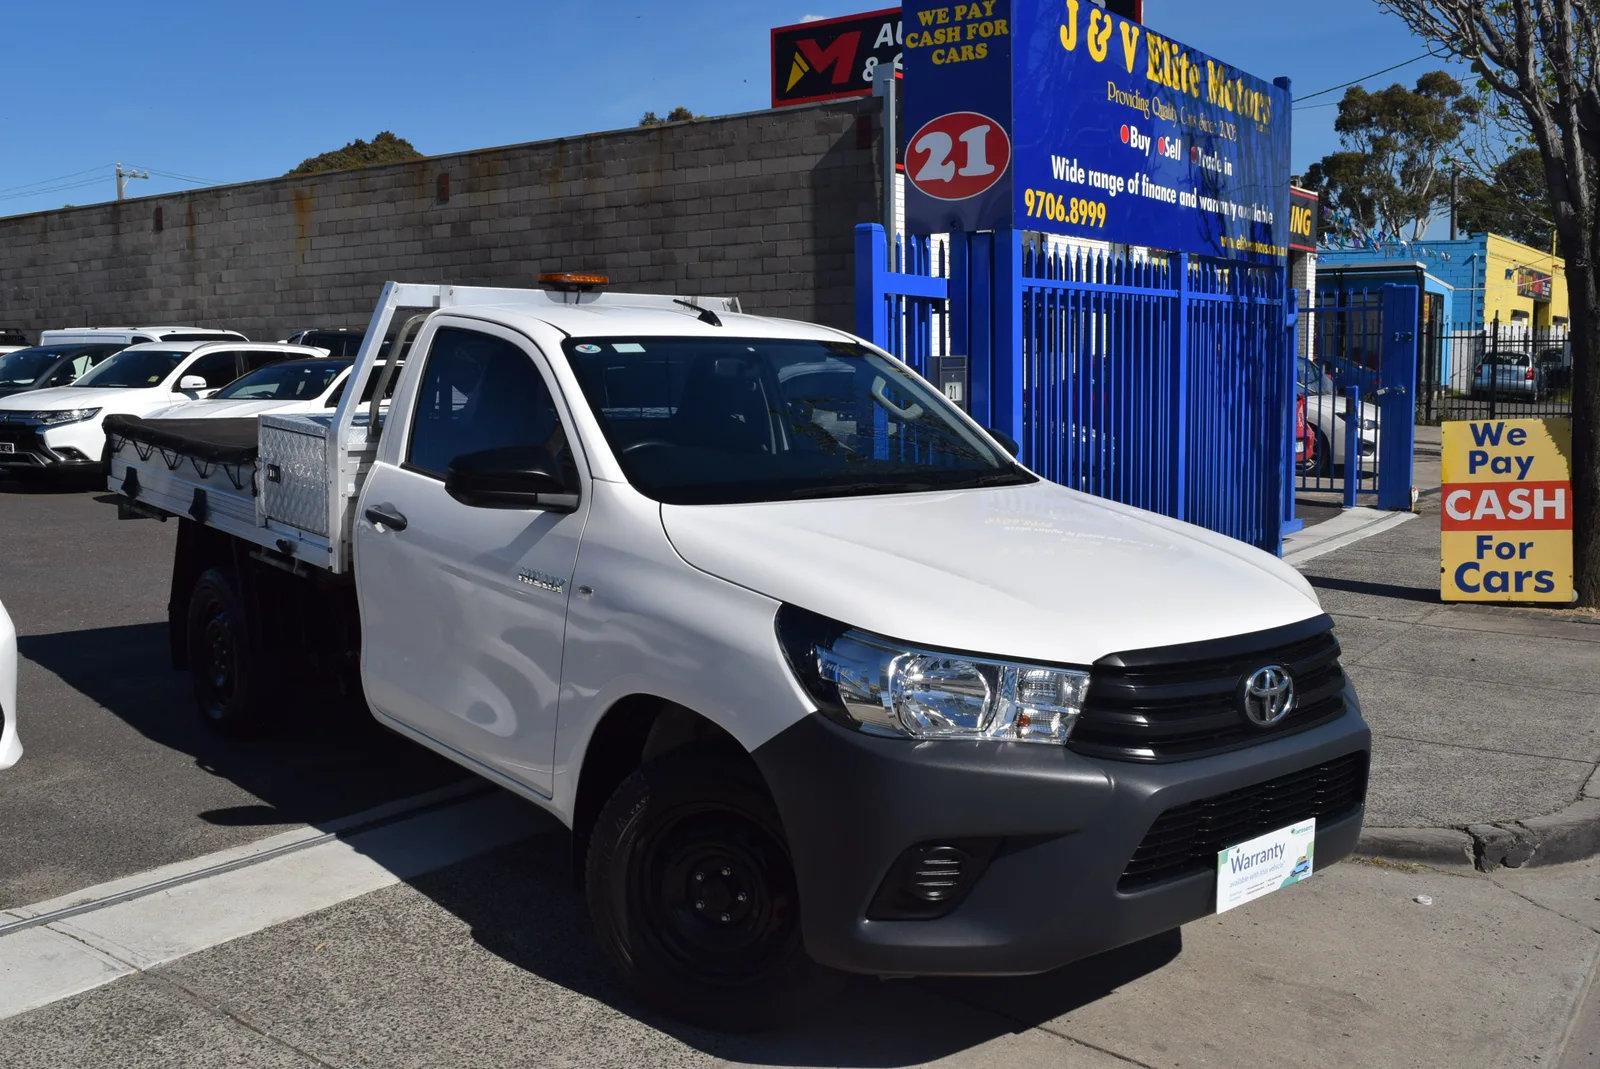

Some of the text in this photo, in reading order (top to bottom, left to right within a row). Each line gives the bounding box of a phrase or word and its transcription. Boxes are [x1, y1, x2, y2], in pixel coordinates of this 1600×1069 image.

[917, 0, 996, 27] WE PAY
[905, 19, 1009, 48] CASH FOR
[931, 43, 988, 65] CARS
[1060, 0, 1271, 124] J & V Elite Motors
[1107, 81, 1150, 120] Providing
[1152, 96, 1178, 128] Quality
[914, 124, 995, 183] 21
[1130, 125, 1232, 177] Buy Sell Trade in
[1051, 154, 1273, 225] Wide range of finance and warranty available
[1024, 188, 1107, 228] 9706.8999
[1469, 422, 1528, 447] We
[1469, 450, 1535, 480] Pay
[1445, 488, 1566, 521] CASH
[1476, 535, 1534, 560] For
[1454, 561, 1555, 593] Cars
[1230, 842, 1286, 874] Warranty
